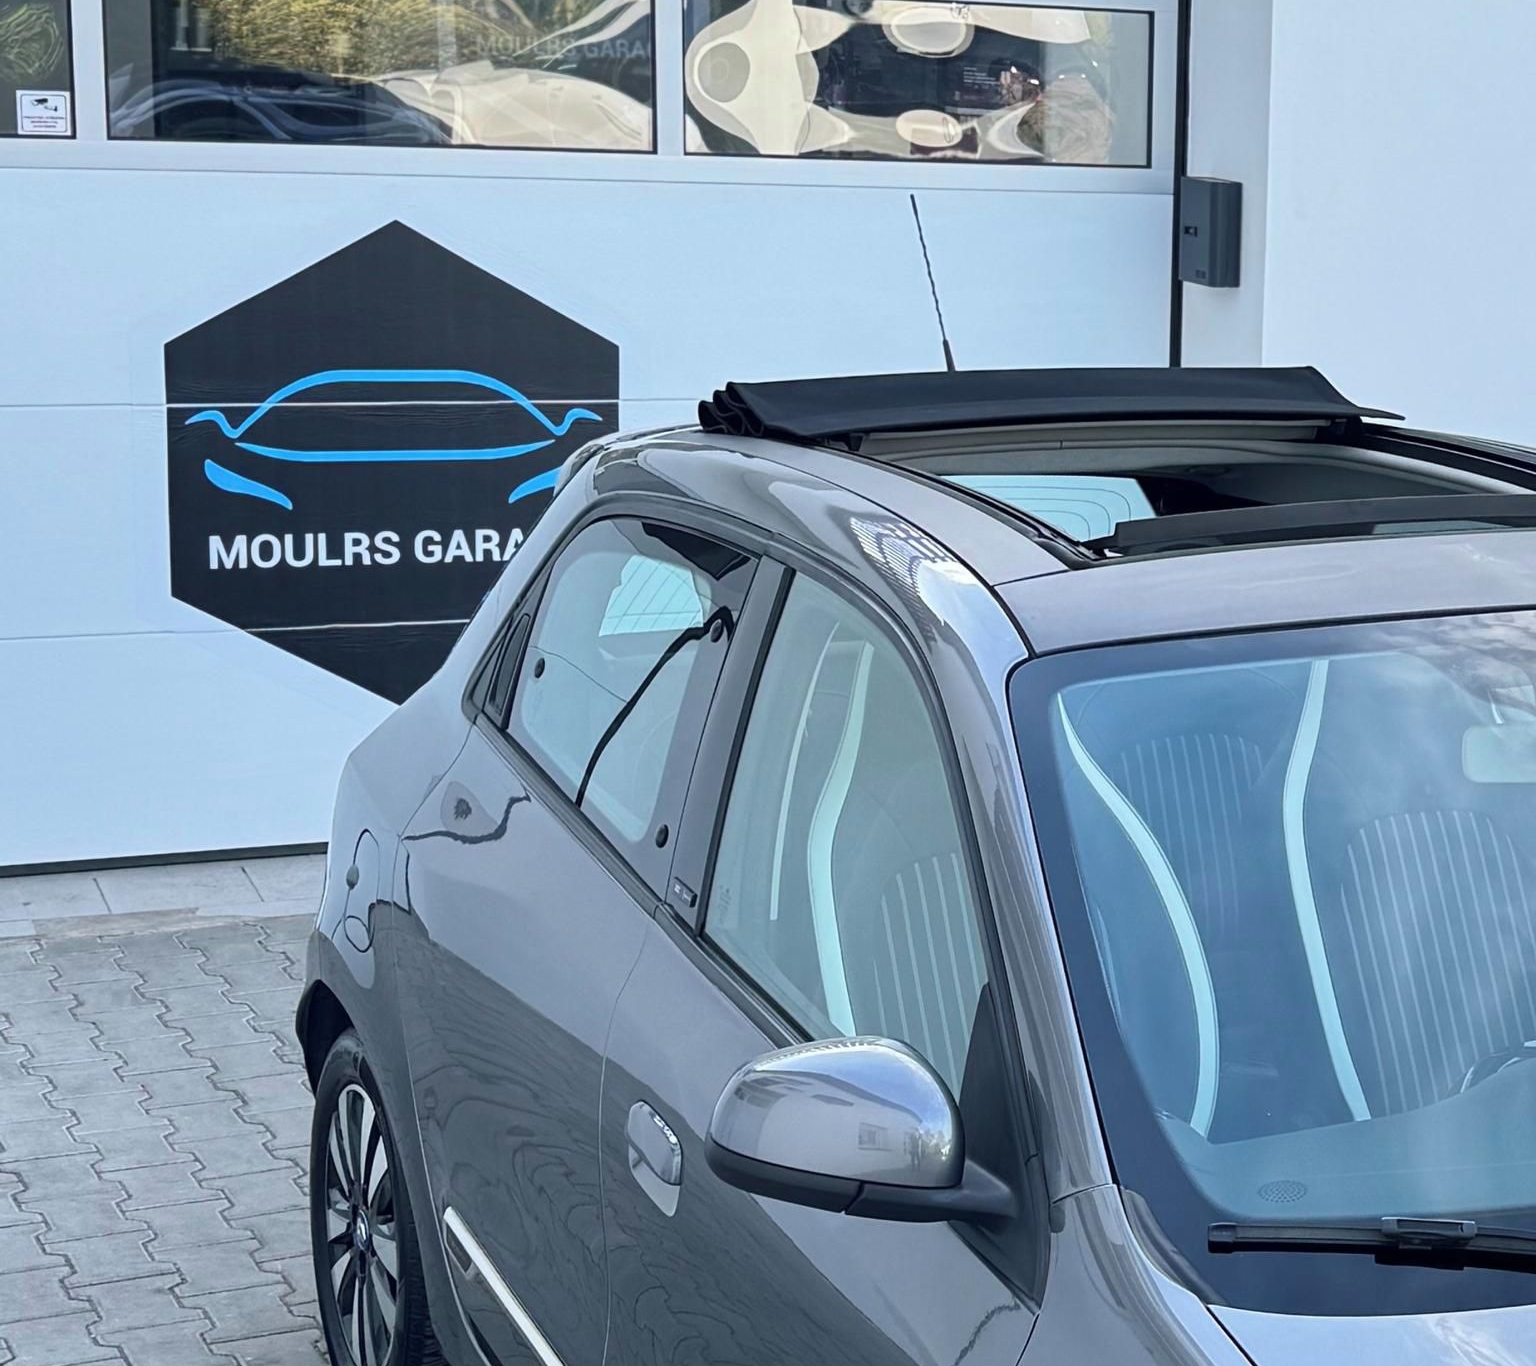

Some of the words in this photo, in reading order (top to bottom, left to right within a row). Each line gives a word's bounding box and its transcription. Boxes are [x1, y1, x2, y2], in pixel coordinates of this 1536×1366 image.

[583, 39, 650, 59] GARA
[208, 531, 401, 570] MOULRS
[414, 528, 524, 565] GARA
